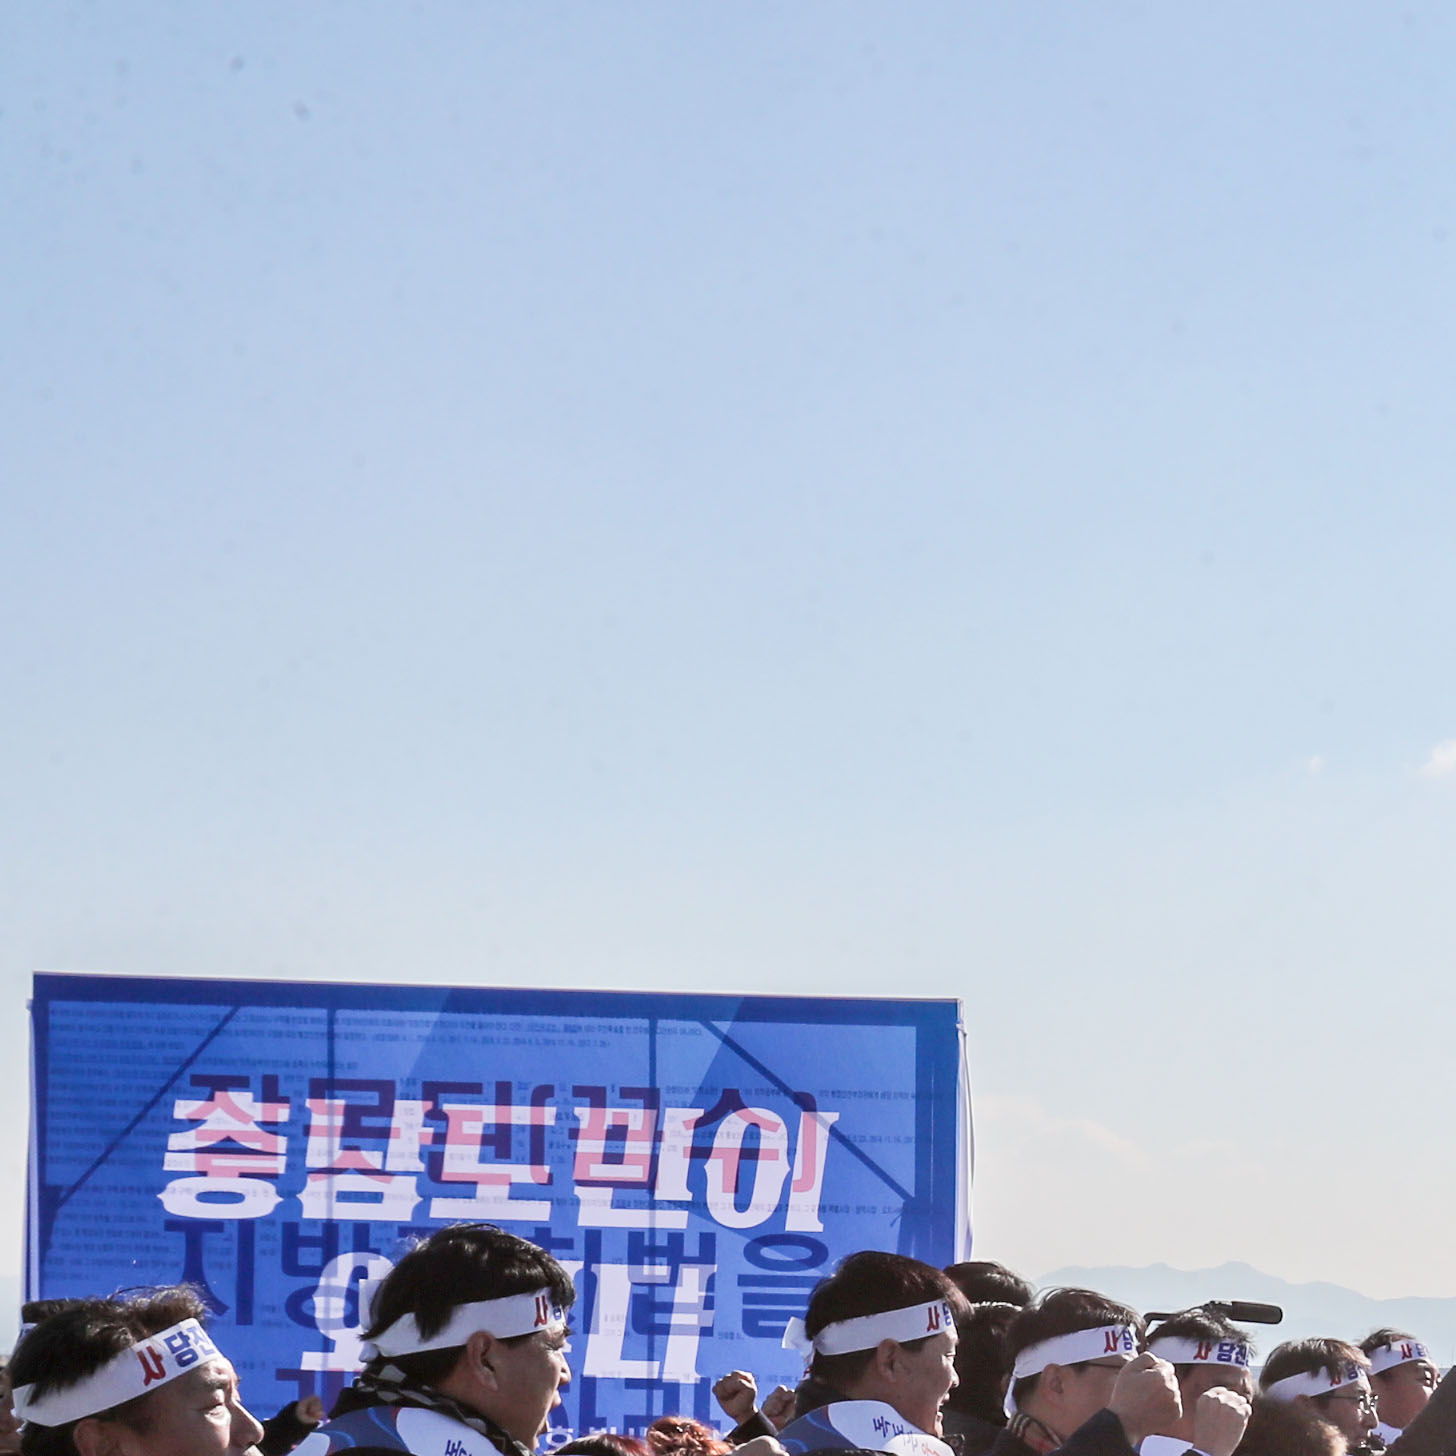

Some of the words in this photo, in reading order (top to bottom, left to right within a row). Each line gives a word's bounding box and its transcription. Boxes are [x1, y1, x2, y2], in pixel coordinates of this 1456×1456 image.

[157, 1091, 840, 1232] 충남도민이
[926, 1304, 940, 1332] 사
[1104, 1330, 1119, 1354] 사
[136, 1345, 166, 1387] 사
